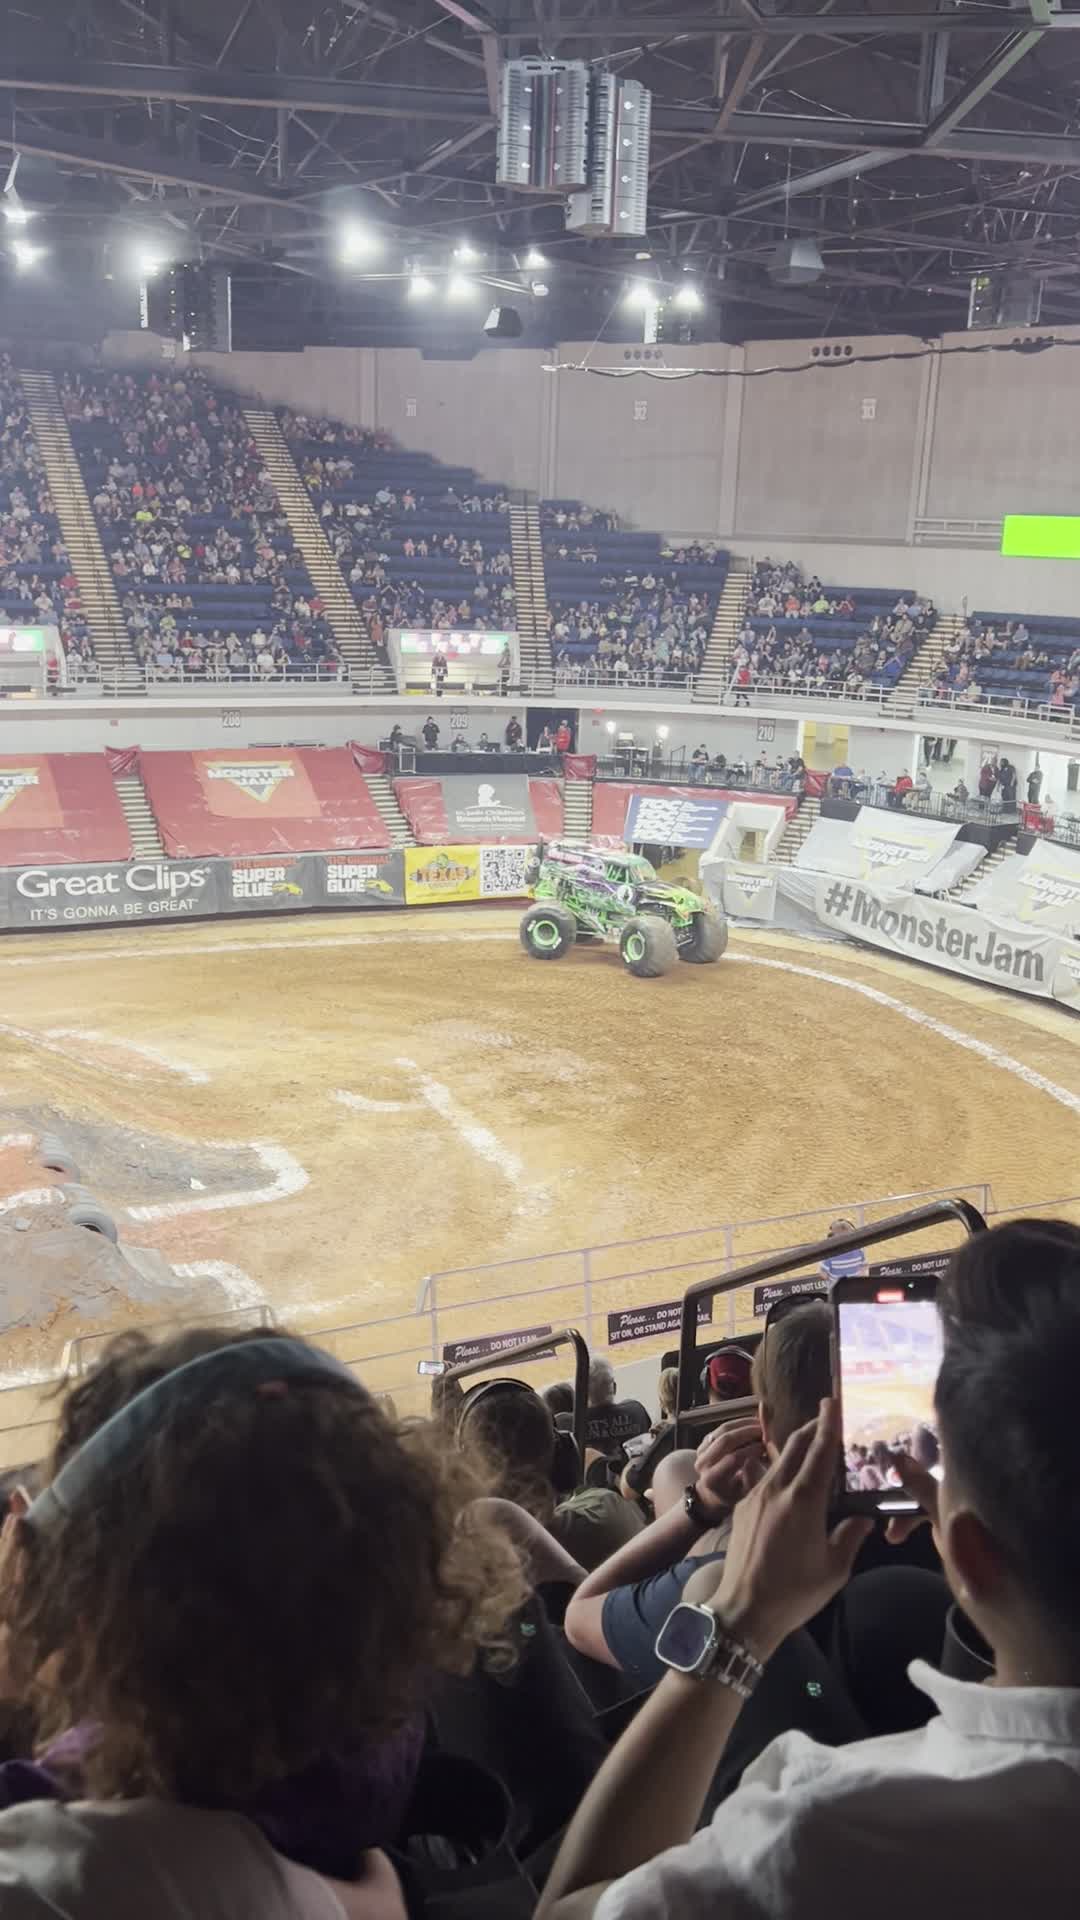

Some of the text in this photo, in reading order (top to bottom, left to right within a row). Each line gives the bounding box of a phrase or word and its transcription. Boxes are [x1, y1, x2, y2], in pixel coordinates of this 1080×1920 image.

[758, 726, 774, 741] 210
[207, 768, 295, 778] MONSTER
[232, 867, 286, 883] SUPER
[327, 865, 377, 879] SUPER
[16, 870, 120, 898] Great
[233, 882, 273, 897] GLUE
[327, 879, 367, 893] GLUE
[31, 899, 198, 921] IT'S GONNA BE GREAT
[824, 882, 1044, 982] #MonsterJam
[912, 1264, 921, 1272] DO
[923, 1261, 934, 1270] NOT
[791, 1285, 801, 1294] DO
[801, 1282, 814, 1292] NOT
[656, 1311, 667, 1320] DO
[667, 1307, 682, 1317] NOT
[610, 1331, 620, 1341] SIT
[634, 1326, 644, 1335] OR
[644, 1321, 667, 1334] STAND
[490, 1341, 501, 1351] DO
[502, 1338, 519, 1349] NOT
